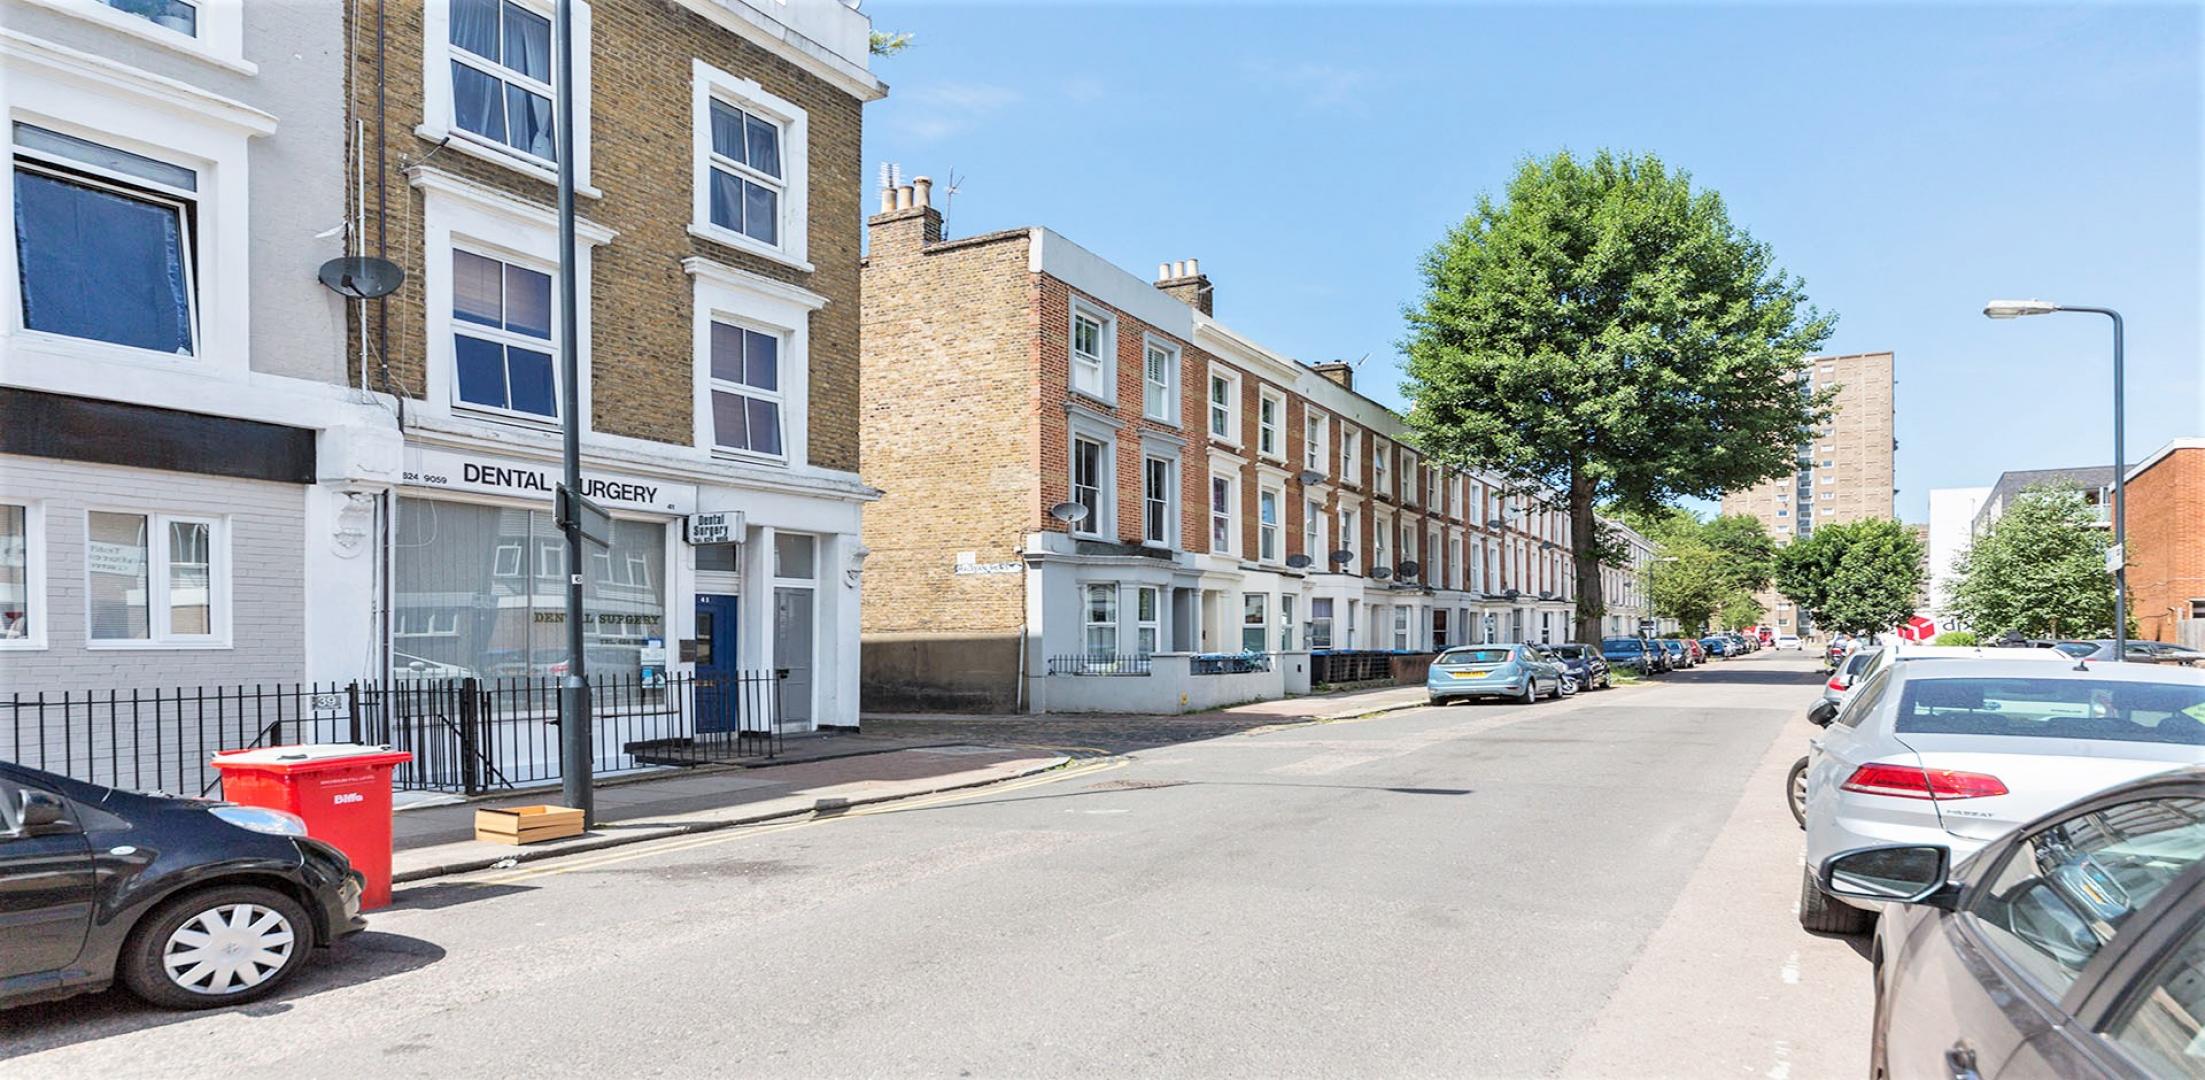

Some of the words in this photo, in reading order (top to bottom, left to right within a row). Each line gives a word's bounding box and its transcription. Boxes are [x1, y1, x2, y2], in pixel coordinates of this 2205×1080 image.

[423, 474, 448, 484] 9059
[463, 462, 553, 492] DENTAL
[579, 479, 658, 503] URGERY
[698, 513, 725, 526] Dental
[693, 525, 728, 537] Surgery
[534, 611, 594, 624] DENL
[317, 695, 337, 707] 39
[333, 792, 364, 805] Biffa
